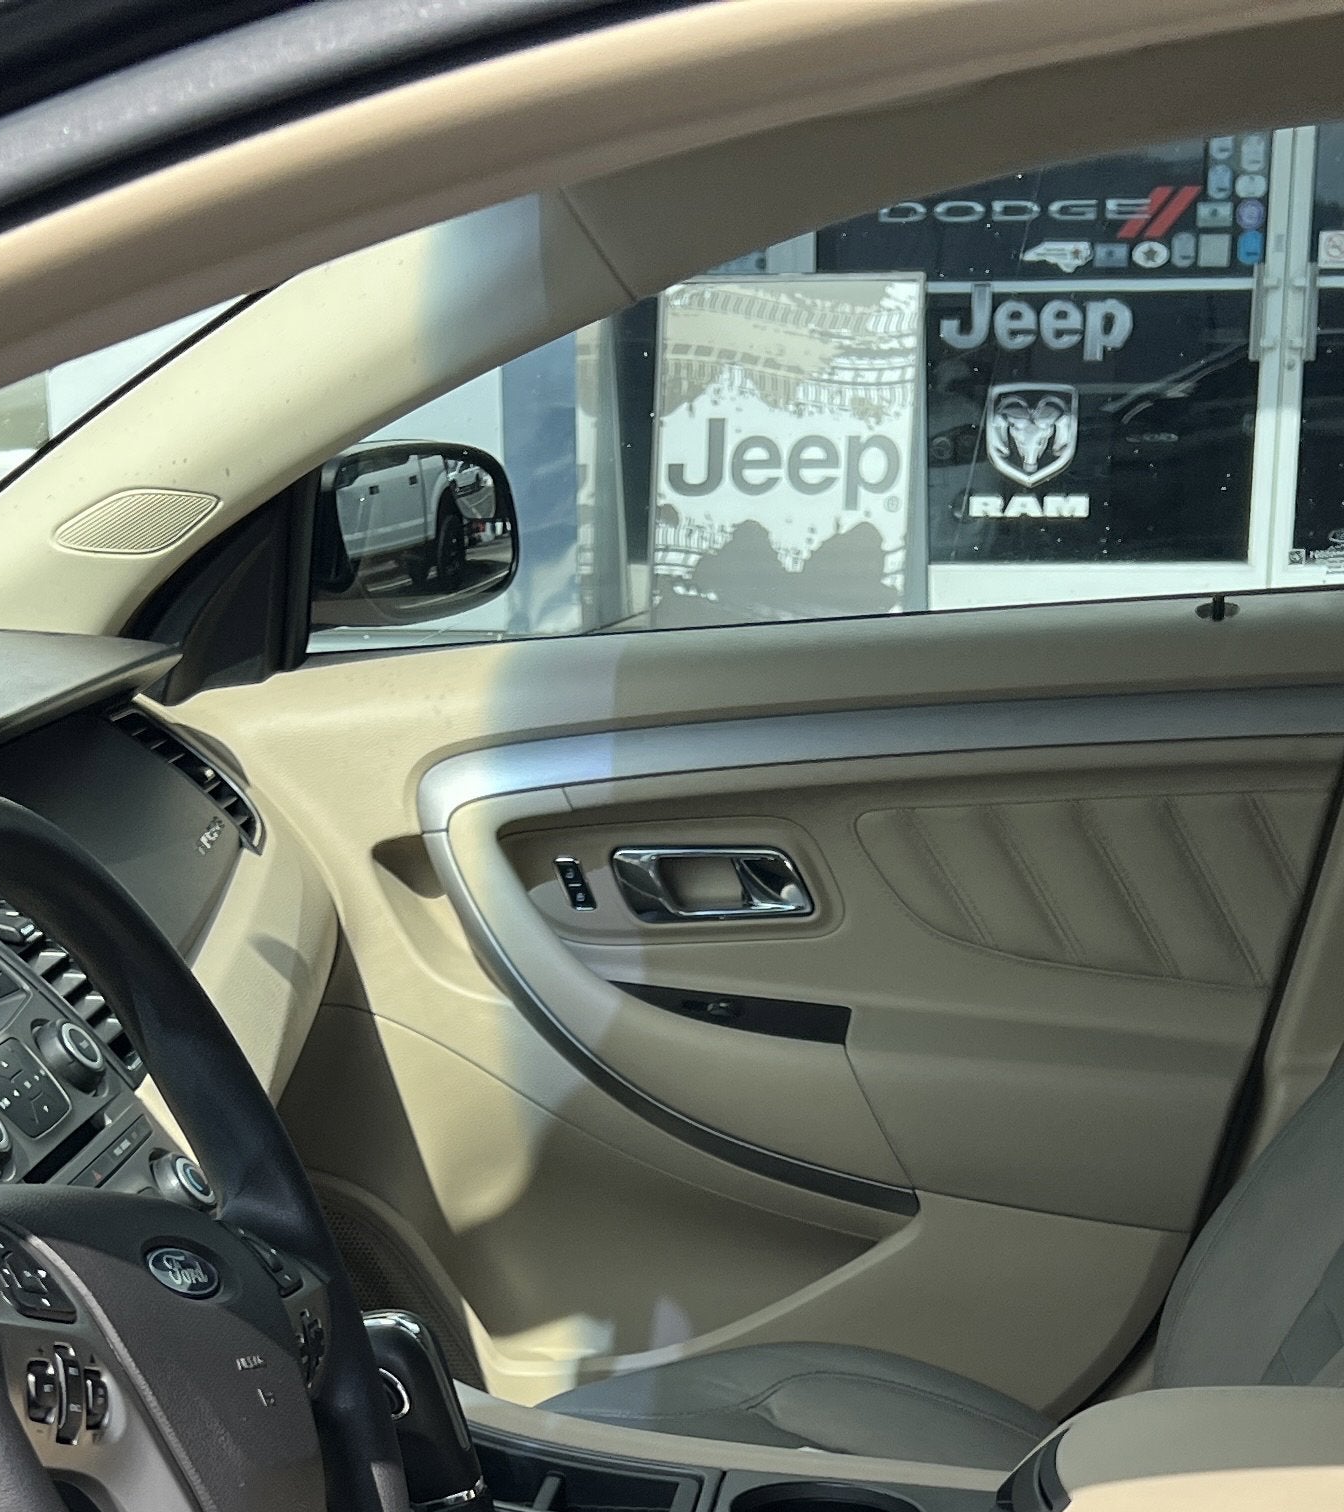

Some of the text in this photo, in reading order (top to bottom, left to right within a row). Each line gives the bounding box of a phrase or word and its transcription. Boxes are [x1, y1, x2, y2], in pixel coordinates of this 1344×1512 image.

[877, 198, 1152, 223] DODGE
[939, 282, 1134, 362] Jeep
[667, 417, 901, 511] Jeep
[968, 493, 1090, 518] RAM
[161, 1253, 209, 1286] Ford
